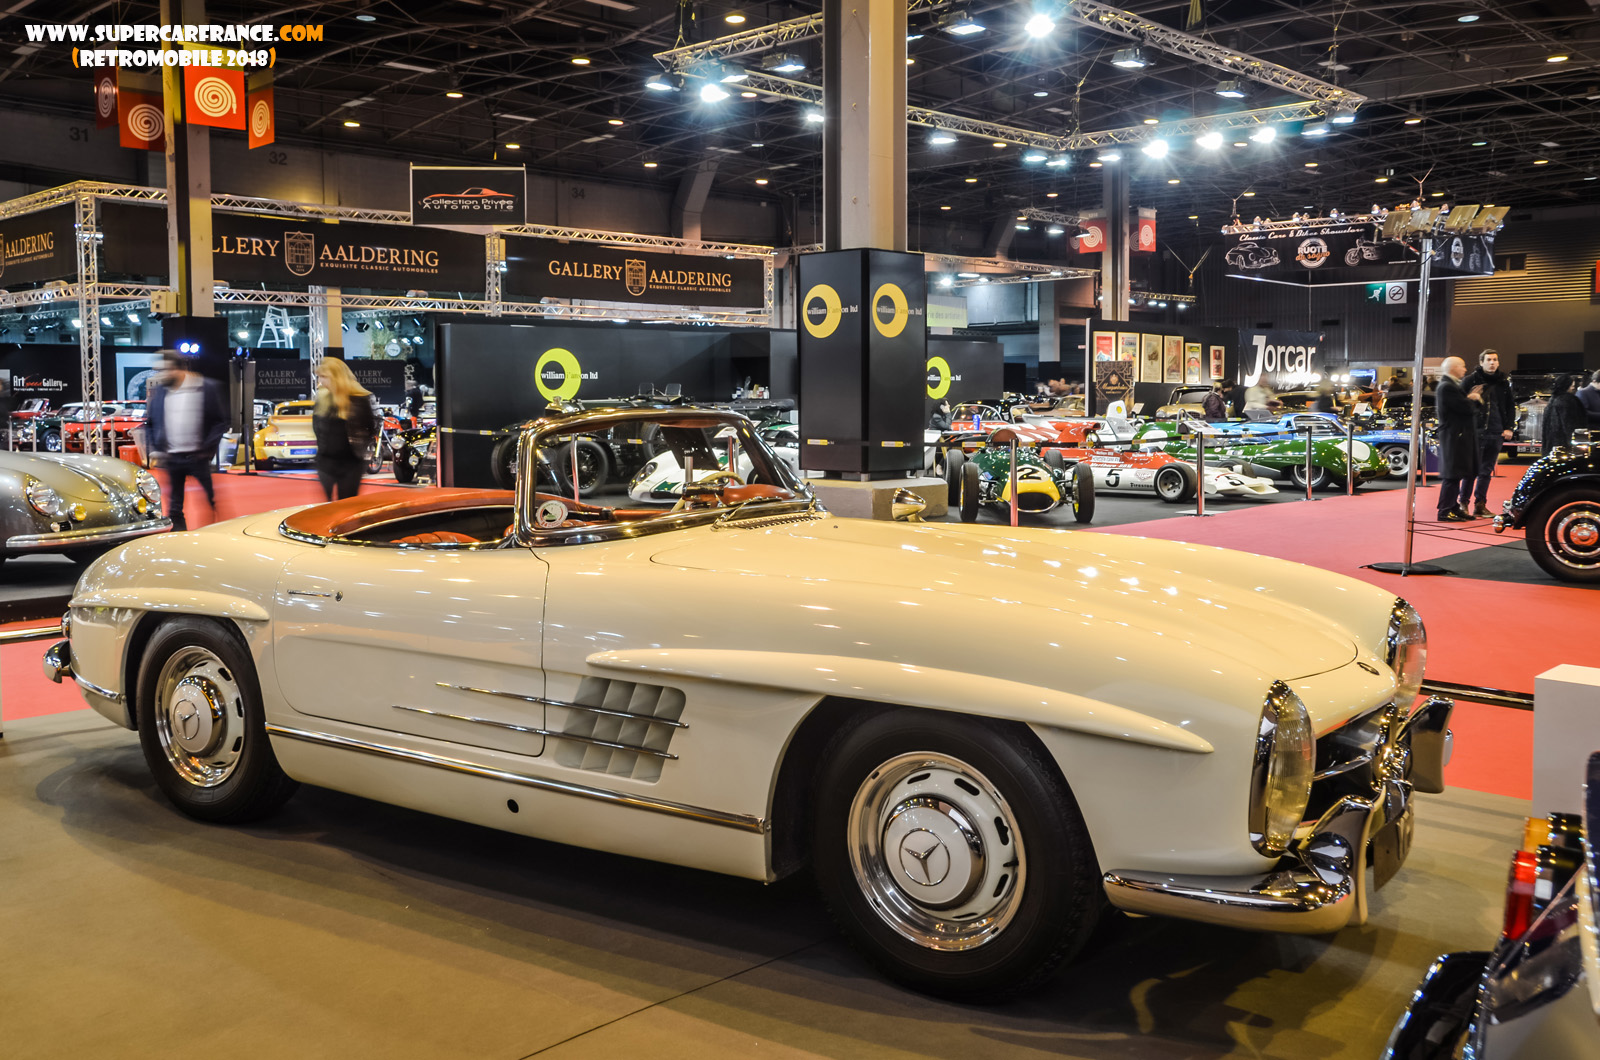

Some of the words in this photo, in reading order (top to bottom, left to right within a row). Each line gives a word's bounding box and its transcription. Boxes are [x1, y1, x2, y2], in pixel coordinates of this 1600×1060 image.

[69, 126, 89, 143] 31
[269, 151, 288, 166] 32
[571, 187, 586, 200] 34
[4, 231, 55, 259] AALDERING
[319, 243, 440, 267] AALDERING
[320, 262, 358, 270] EXQUISITE
[360, 264, 389, 272] CLASSIC
[393, 266, 439, 274] AUTOMOBILES
[548, 259, 624, 281] GALLERY
[649, 269, 732, 287] AALDERING
[807, 306, 826, 315] william
[850, 304, 858, 313] ltd
[876, 305, 896, 314] william
[915, 307, 923, 316] ltd
[1244, 334, 1317, 388] Jorcar
[258, 370, 297, 378] GALLERY
[541, 370, 566, 380] william
[589, 371, 599, 380] ltd
[13, 375, 26, 387] Art
[42, 378, 63, 391] Gallery
[1017, 467, 1042, 481] 2
[1105, 468, 1123, 488] 5
